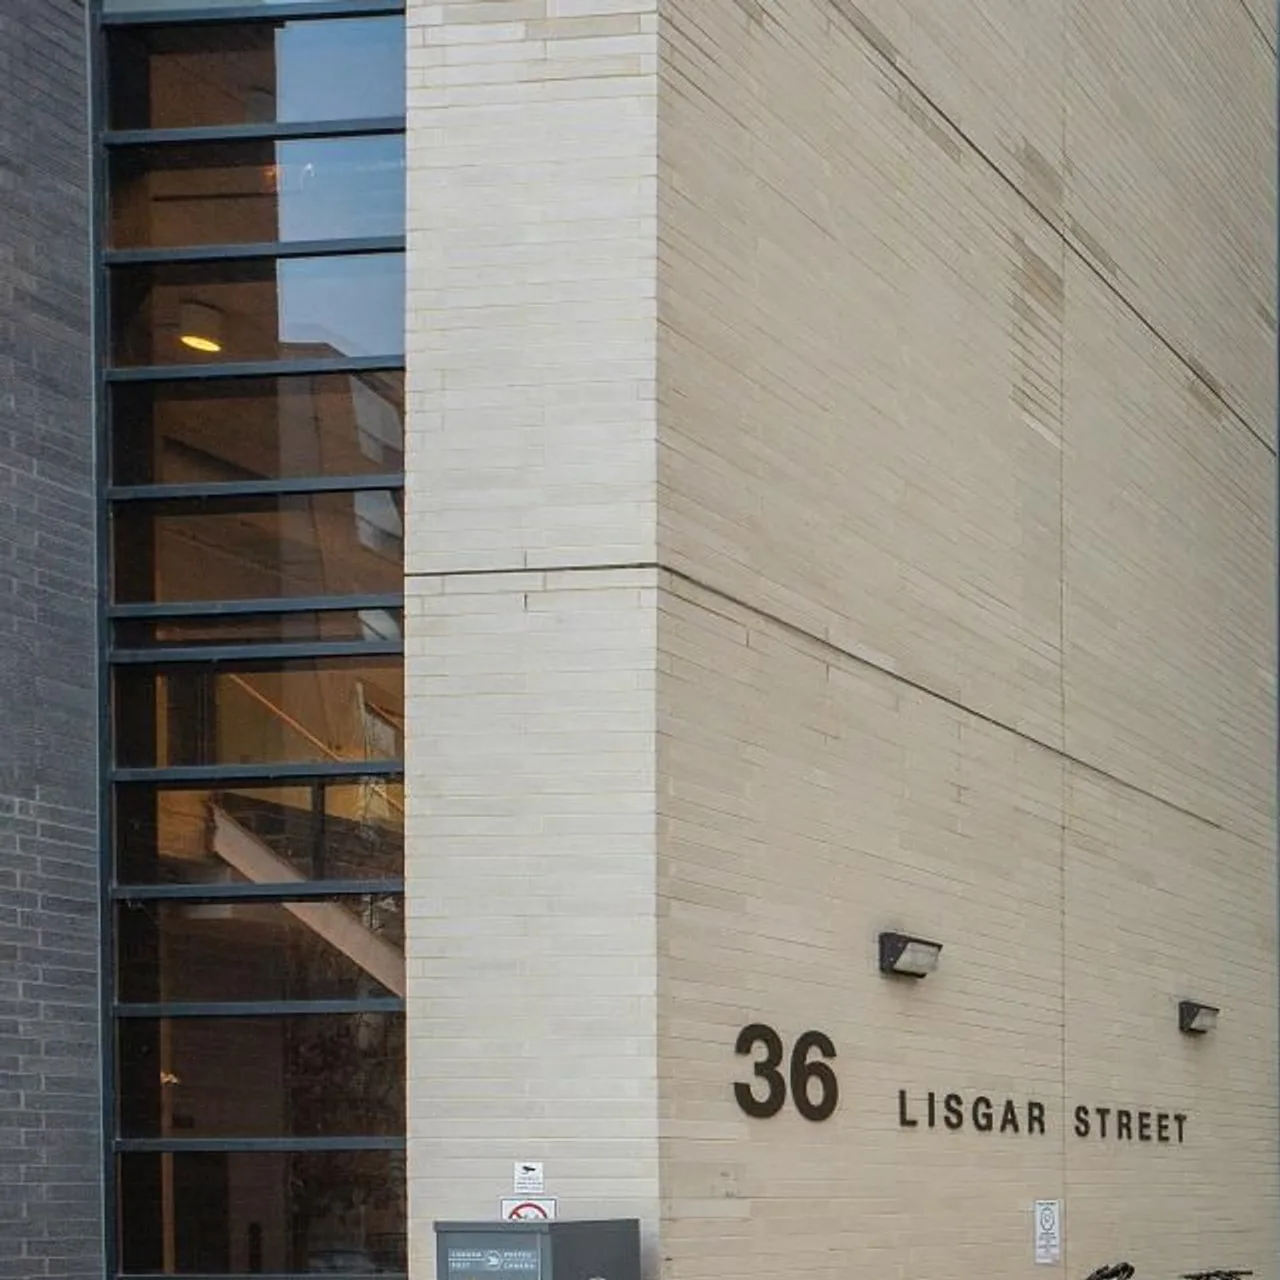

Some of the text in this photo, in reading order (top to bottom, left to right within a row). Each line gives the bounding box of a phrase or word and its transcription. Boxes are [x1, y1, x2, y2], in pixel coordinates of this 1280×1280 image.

[733, 1023, 839, 1123] 36
[898, 1089, 1188, 1144] LISGAR STREET
